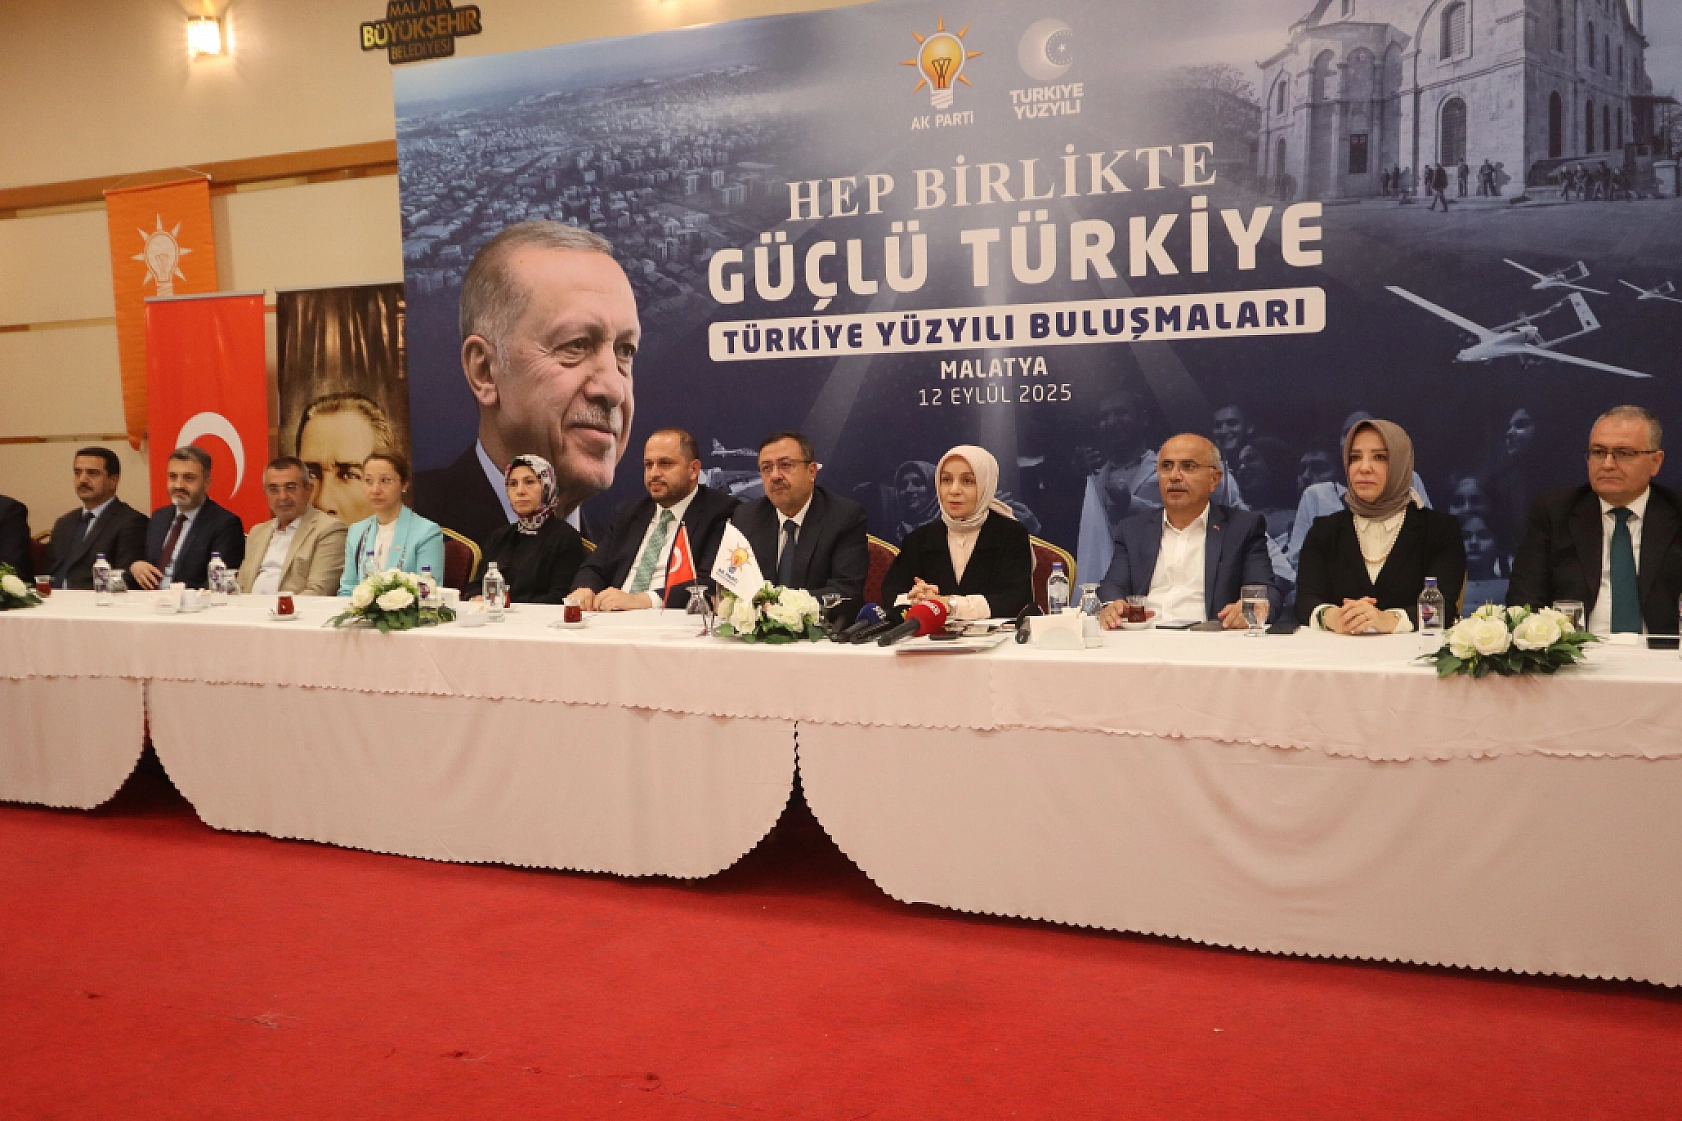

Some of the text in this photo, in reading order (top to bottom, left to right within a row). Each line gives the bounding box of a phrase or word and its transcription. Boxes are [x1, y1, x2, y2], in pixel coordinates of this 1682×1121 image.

[911, 115, 931, 130] AK
[785, 141, 1217, 222] HEP BİRLİKTE
[708, 195, 1323, 312] GÜÇLÜ TÜRKİYE
[722, 298, 1305, 354] TÜRKİYE YÜZYILI BULUŞMALARI
[940, 355, 1049, 380] MALATYA
[918, 382, 1072, 406] 12 EYLÜL 2025
